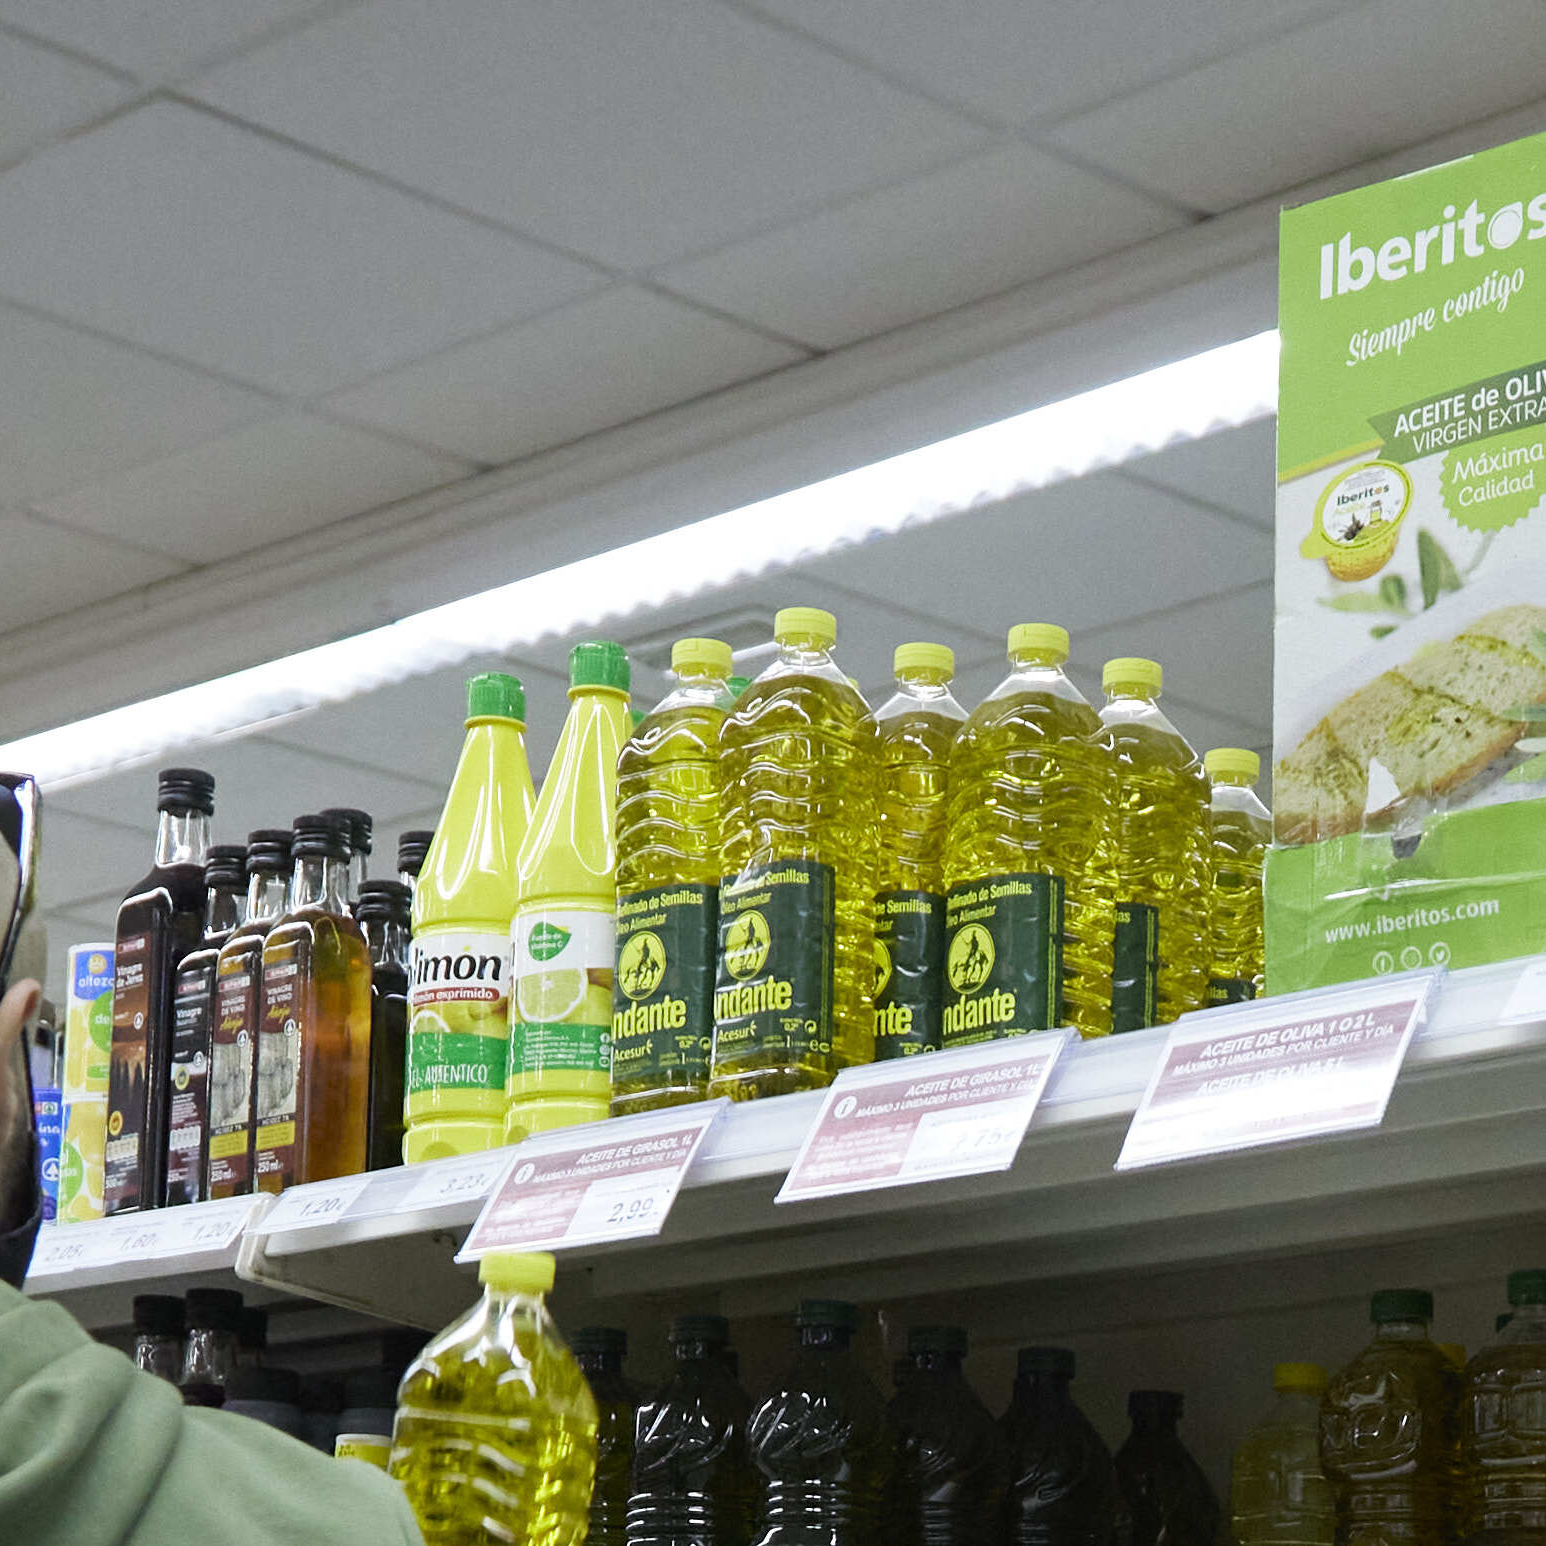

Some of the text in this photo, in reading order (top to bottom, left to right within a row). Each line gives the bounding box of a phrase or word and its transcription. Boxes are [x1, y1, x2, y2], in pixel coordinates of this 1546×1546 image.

[1346, 267, 1525, 367] Siempre contigo
[1394, 394, 1466, 437] ACEITE
[1471, 387, 1499, 411] de
[1413, 416, 1482, 454] VIRGEN
[1452, 443, 1544, 484] Máxima
[1337, 483, 1390, 506] Iberitos
[1458, 470, 1534, 507] Calidad
[766, 868, 810, 885] Semillas
[660, 890, 704, 907] Semillas
[737, 891, 772, 908] Alimentar
[991, 881, 1032, 899] Semillas
[887, 899, 932, 914] Semillas
[960, 905, 996, 922] Alimentar
[630, 913, 667, 931] Alimentar
[1325, 896, 1500, 944] www.iberitos.com
[436, 987, 493, 1001] exprimido
[714, 975, 793, 1020] ndante
[613, 994, 687, 1041] ndante
[943, 988, 1017, 1036] ndante
[717, 1027, 750, 1042] Acesur
[1200, 1023, 1324, 1058] ACEITE DE OLIVA
[614, 1044, 647, 1062] Acesur
[1227, 1045, 1286, 1066] UNIDADES
[1287, 1040, 1312, 1055] POR
[1314, 1033, 1363, 1051] CLIENTE
[905, 1080, 948, 1097] ACEITE
[950, 1074, 968, 1089] DE
[969, 1067, 1023, 1086] GIRASOL
[968, 1085, 1008, 1101] CLIENTE
[1197, 1074, 1251, 1096] ACEITE
[576, 1138, 678, 1164] ACEITE DE GIRASOL
[606, 1198, 658, 1224] 2,99
